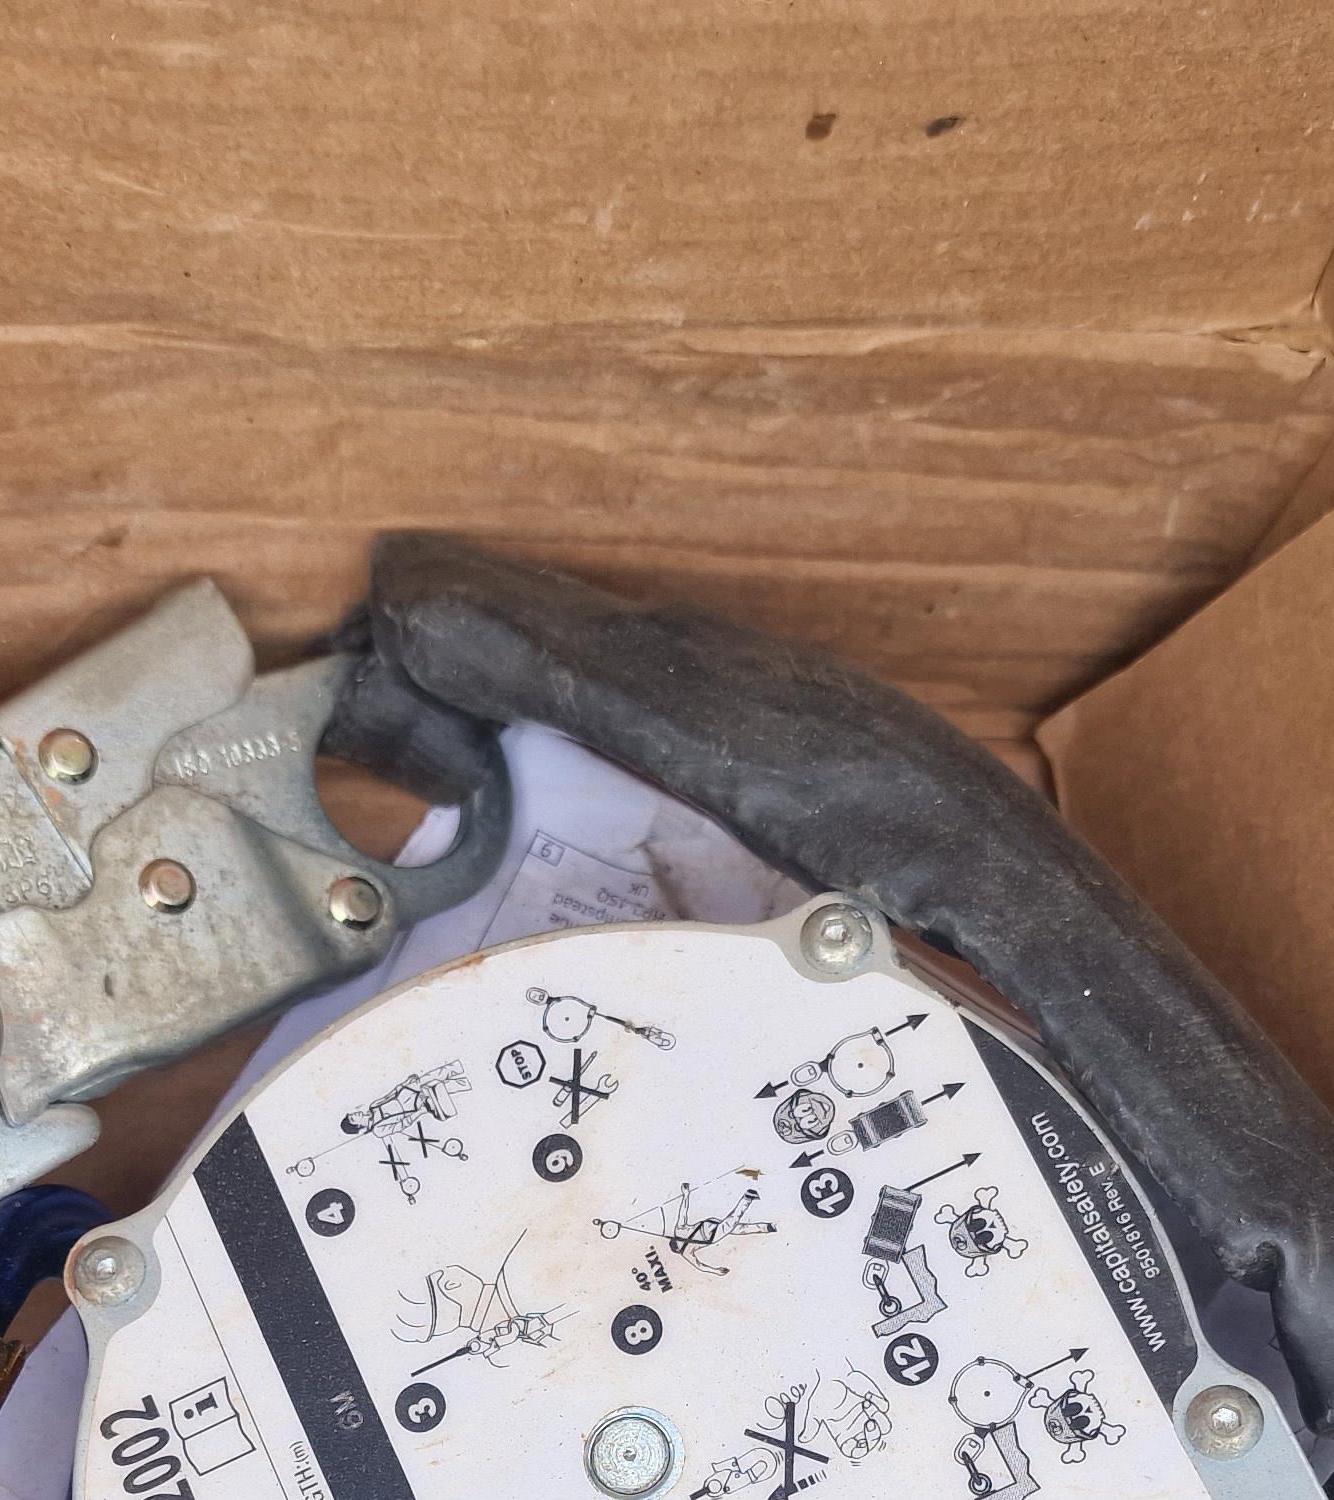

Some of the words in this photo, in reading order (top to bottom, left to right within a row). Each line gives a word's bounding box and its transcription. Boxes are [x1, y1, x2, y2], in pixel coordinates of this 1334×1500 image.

[510, 1048, 533, 1081] STOP
[1088, 1161, 1105, 1177] E
[808, 1172, 845, 1214] 13
[1101, 1176, 1125, 1212] Rev.
[1031, 1112, 1166, 1352] www.capitalsafety.com
[1116, 1212, 1160, 1279] 9501816
[643, 1245, 674, 1293] MAXI.
[892, 1337, 930, 1384] 12
